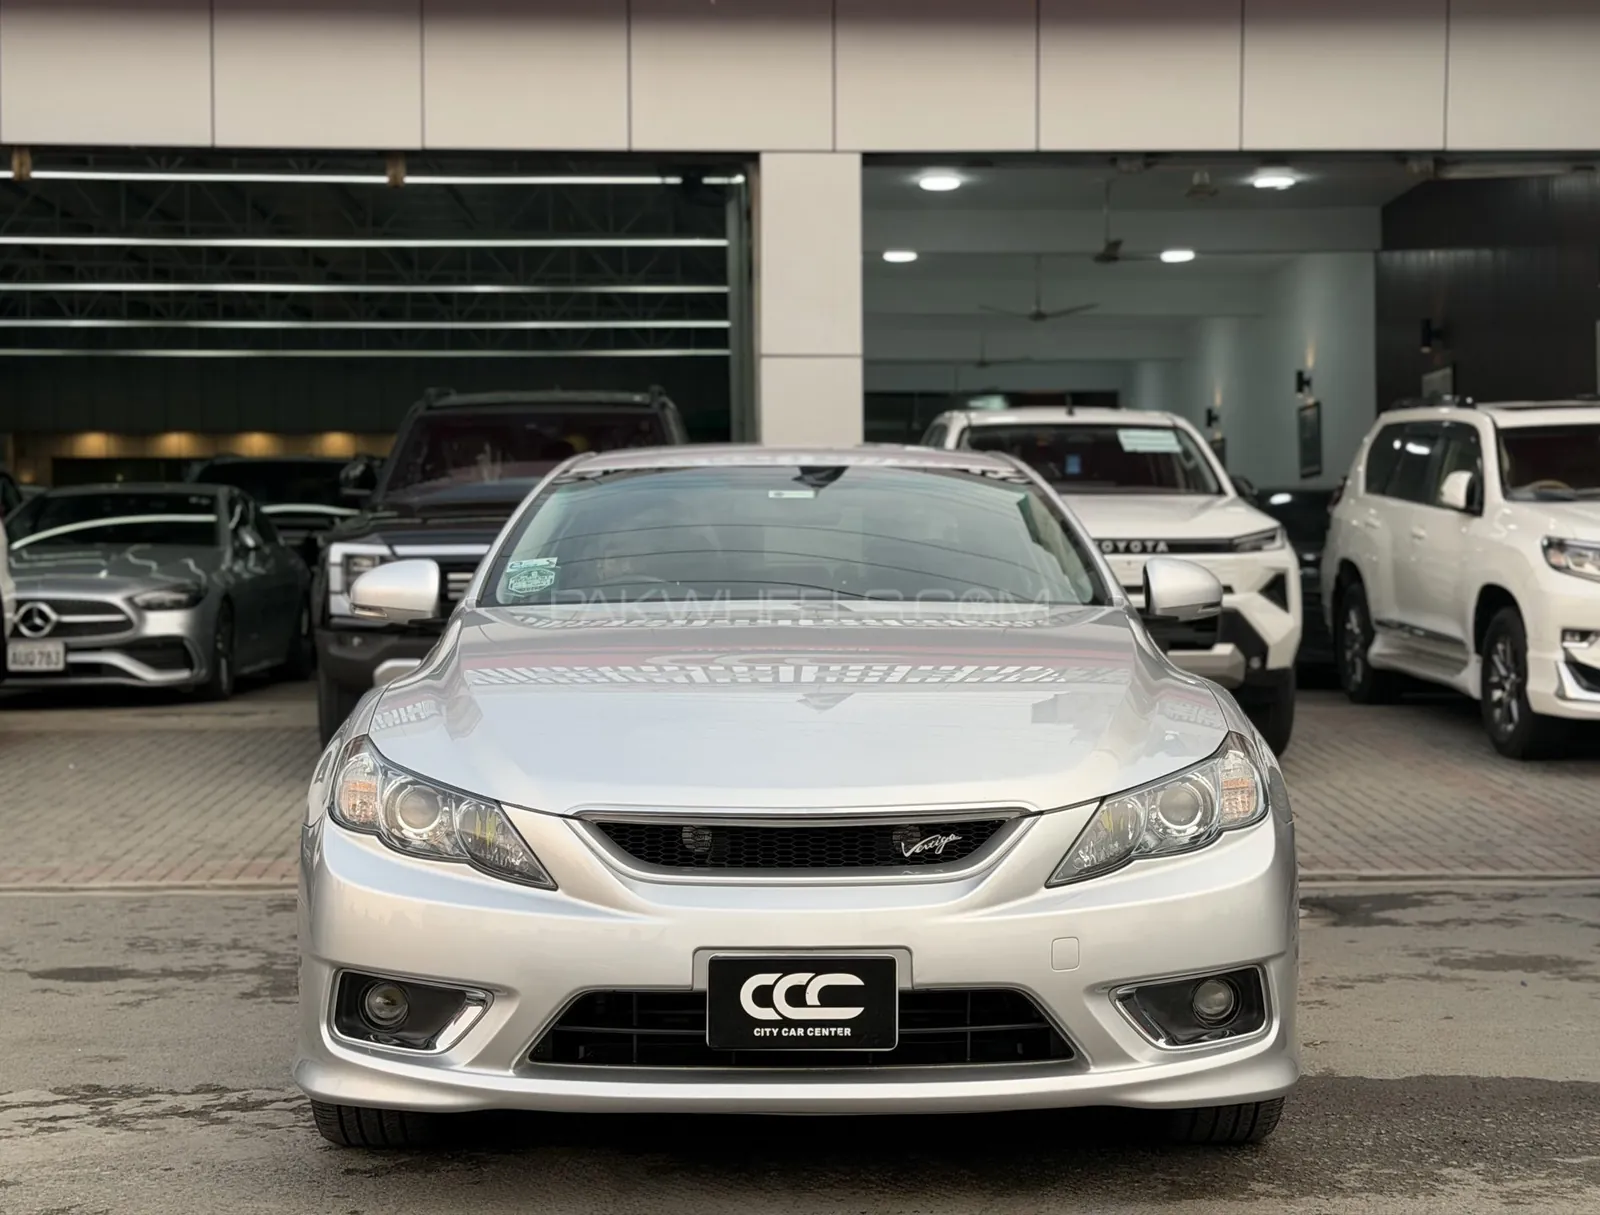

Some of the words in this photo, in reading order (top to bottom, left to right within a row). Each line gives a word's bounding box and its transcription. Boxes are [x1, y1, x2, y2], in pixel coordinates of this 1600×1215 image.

[740, 973, 865, 1020] CCC
[753, 1027, 779, 1037] CITY
[781, 1027, 804, 1037] CAR
[807, 1027, 851, 1037] CENTER
